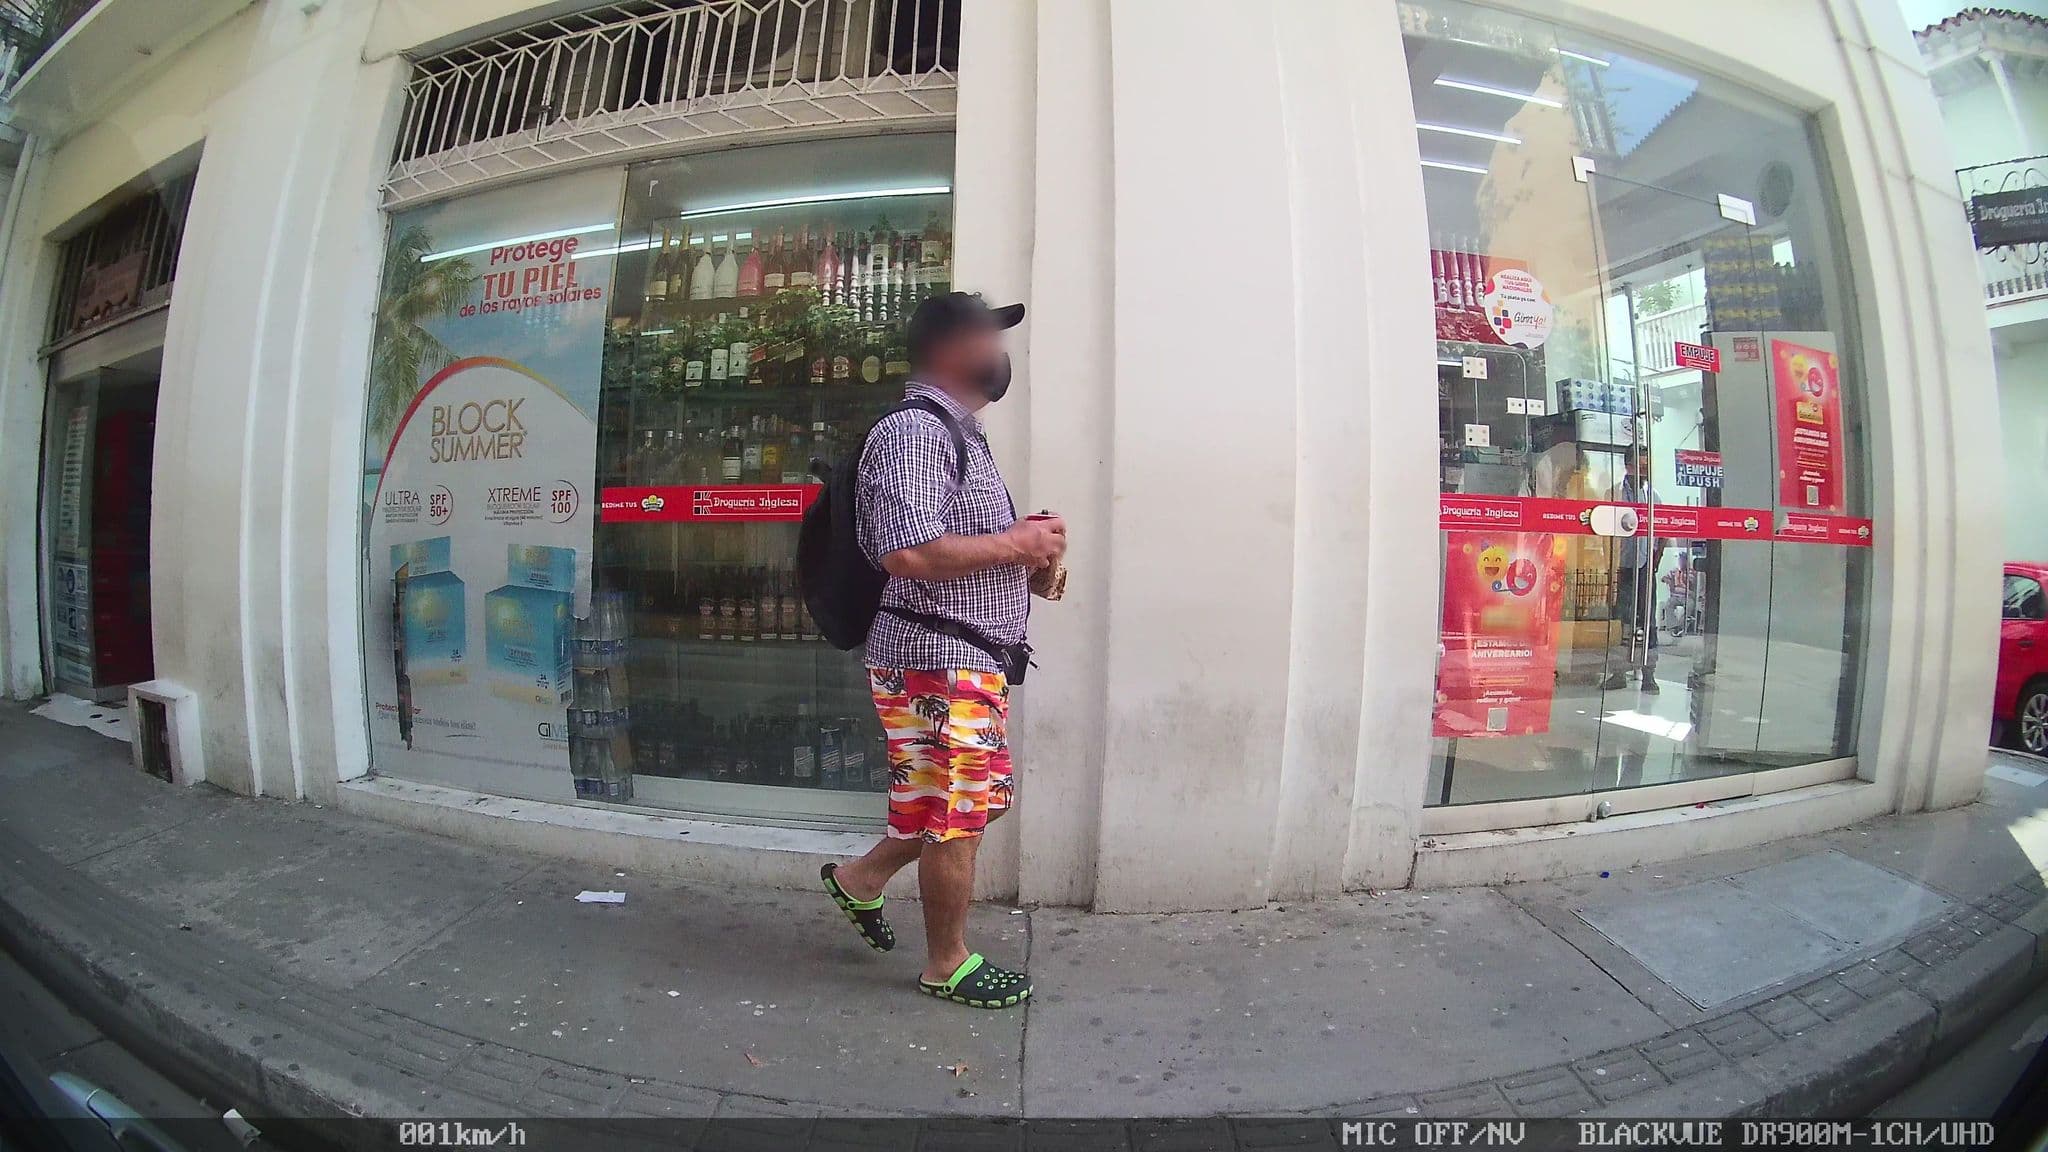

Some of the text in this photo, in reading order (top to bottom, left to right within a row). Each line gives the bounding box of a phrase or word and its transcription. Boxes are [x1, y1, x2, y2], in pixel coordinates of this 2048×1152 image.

[490, 237, 578, 266] Protege
[484, 261, 578, 301] TU PIEL
[459, 287, 602, 318] de los rayos solares
[1681, 344, 1715, 362] EMPUJE
[431, 397, 526, 437] BLOCK
[429, 431, 524, 464] SUMMER
[1686, 463, 1725, 477] EMPUJE
[1688, 475, 1721, 488] PUSH
[385, 490, 421, 506] ULTRA
[430, 494, 447, 505] SPF
[487, 486, 542, 503] XTREME
[551, 490, 572, 501] SPF
[430, 506, 448, 517] 50+
[550, 502, 571, 514] 100
[625, 501, 638, 509] TUS
